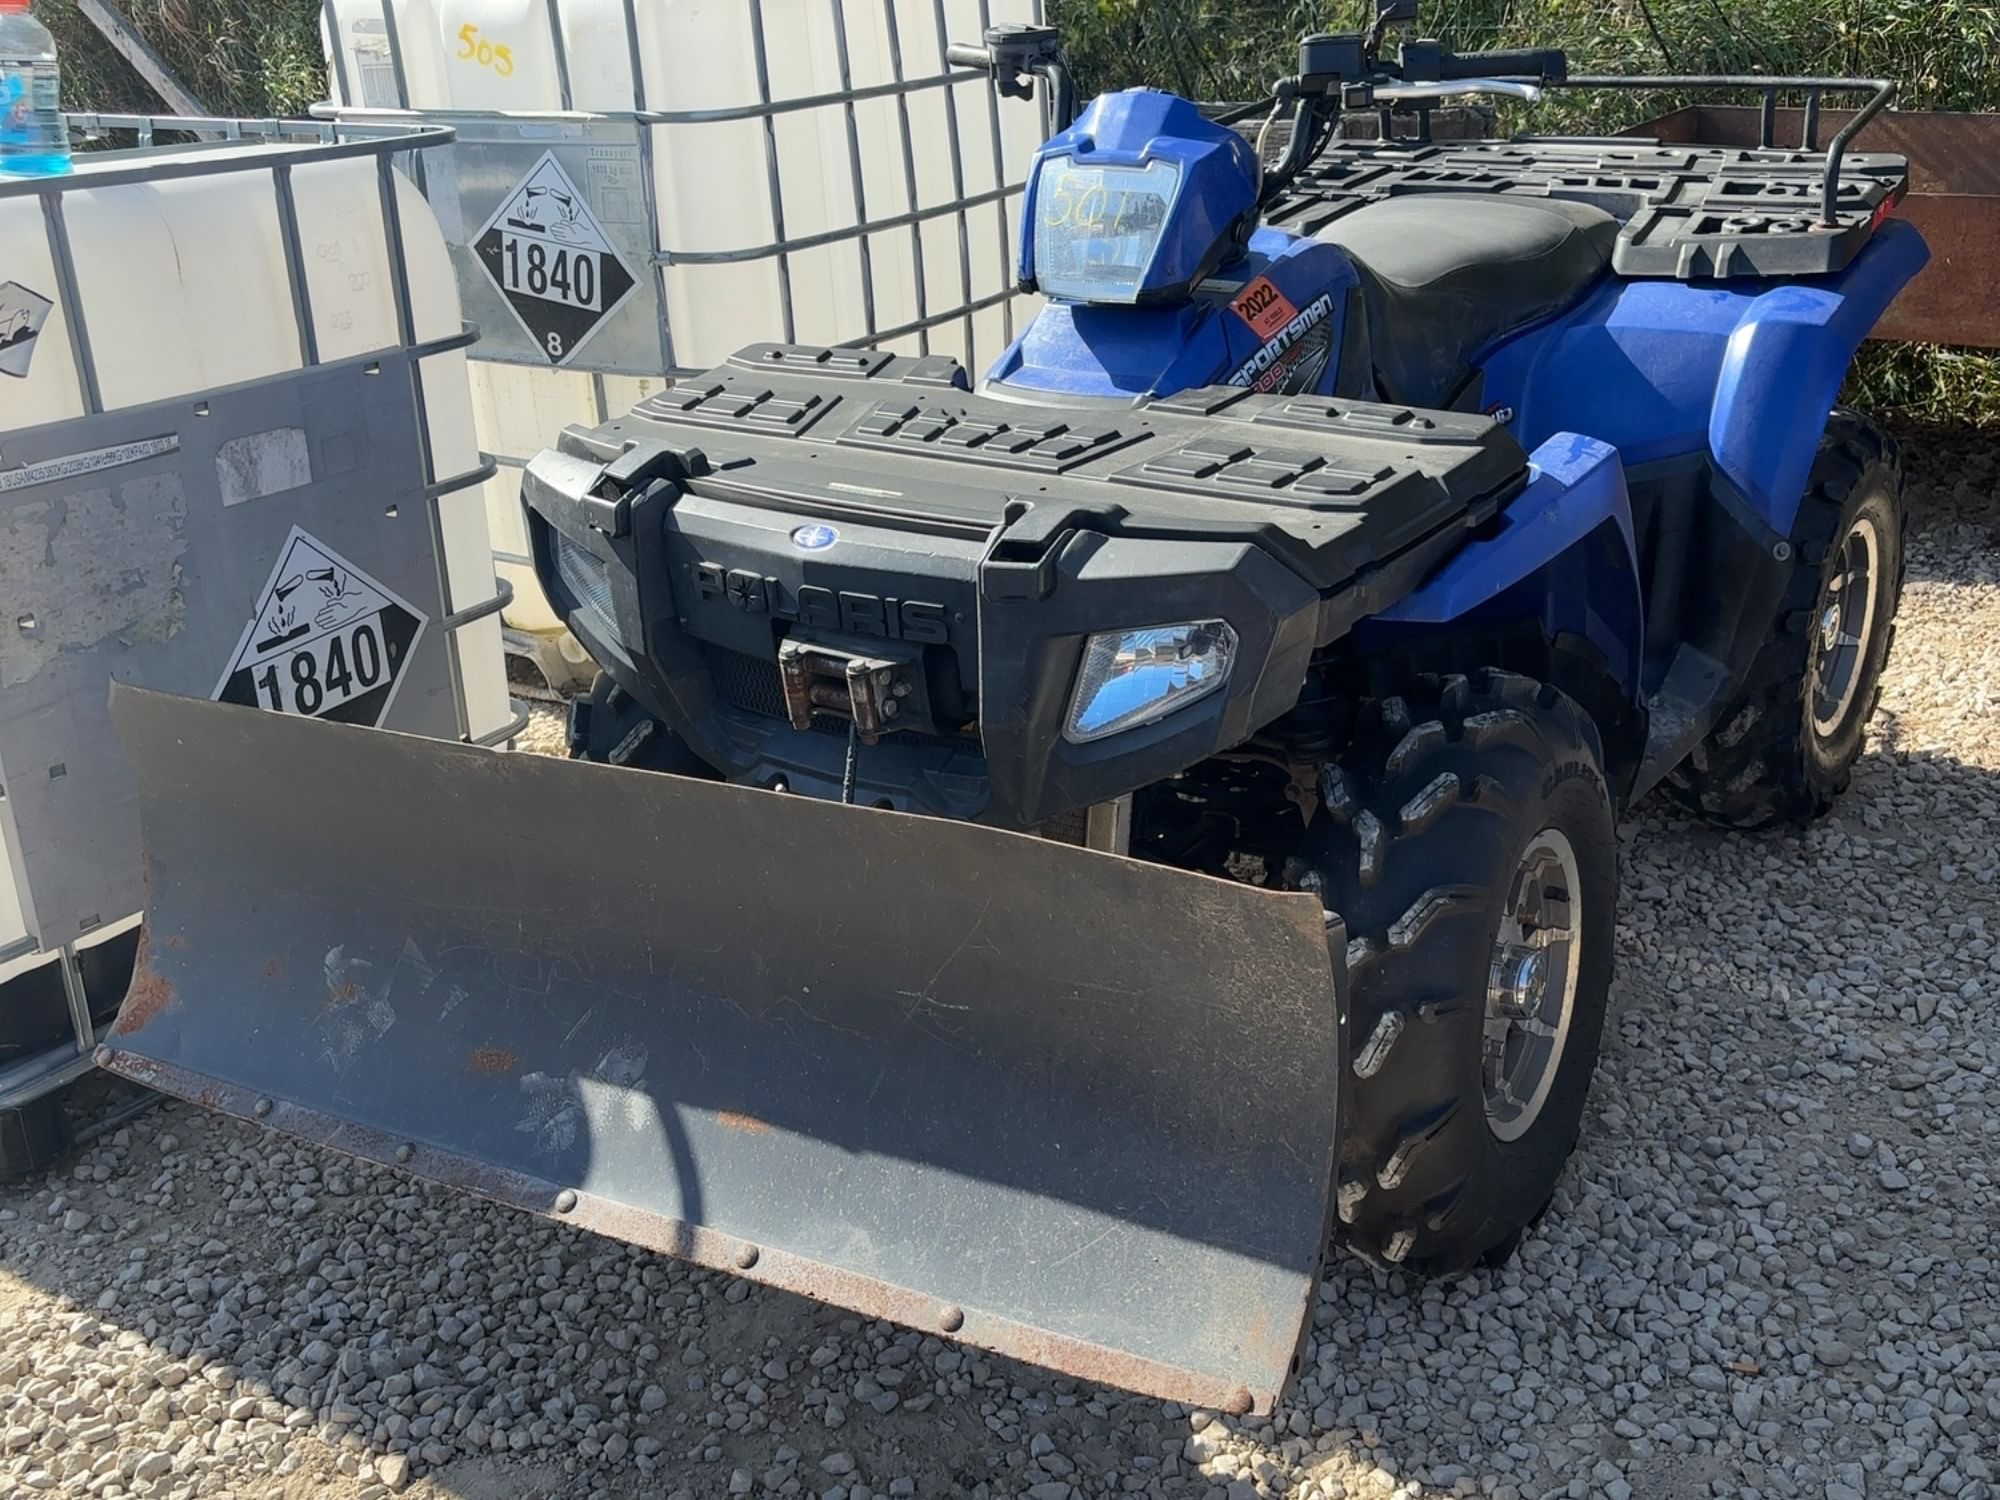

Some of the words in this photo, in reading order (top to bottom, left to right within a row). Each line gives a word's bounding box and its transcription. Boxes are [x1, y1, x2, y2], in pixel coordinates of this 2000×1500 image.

[505, 238, 594, 306] 1840
[1238, 283, 1279, 321] 2022
[547, 332, 563, 356] 8
[1227, 293, 1334, 386] SPORTSMAN
[692, 561, 949, 645] POLARIS
[258, 624, 381, 715] 1840
